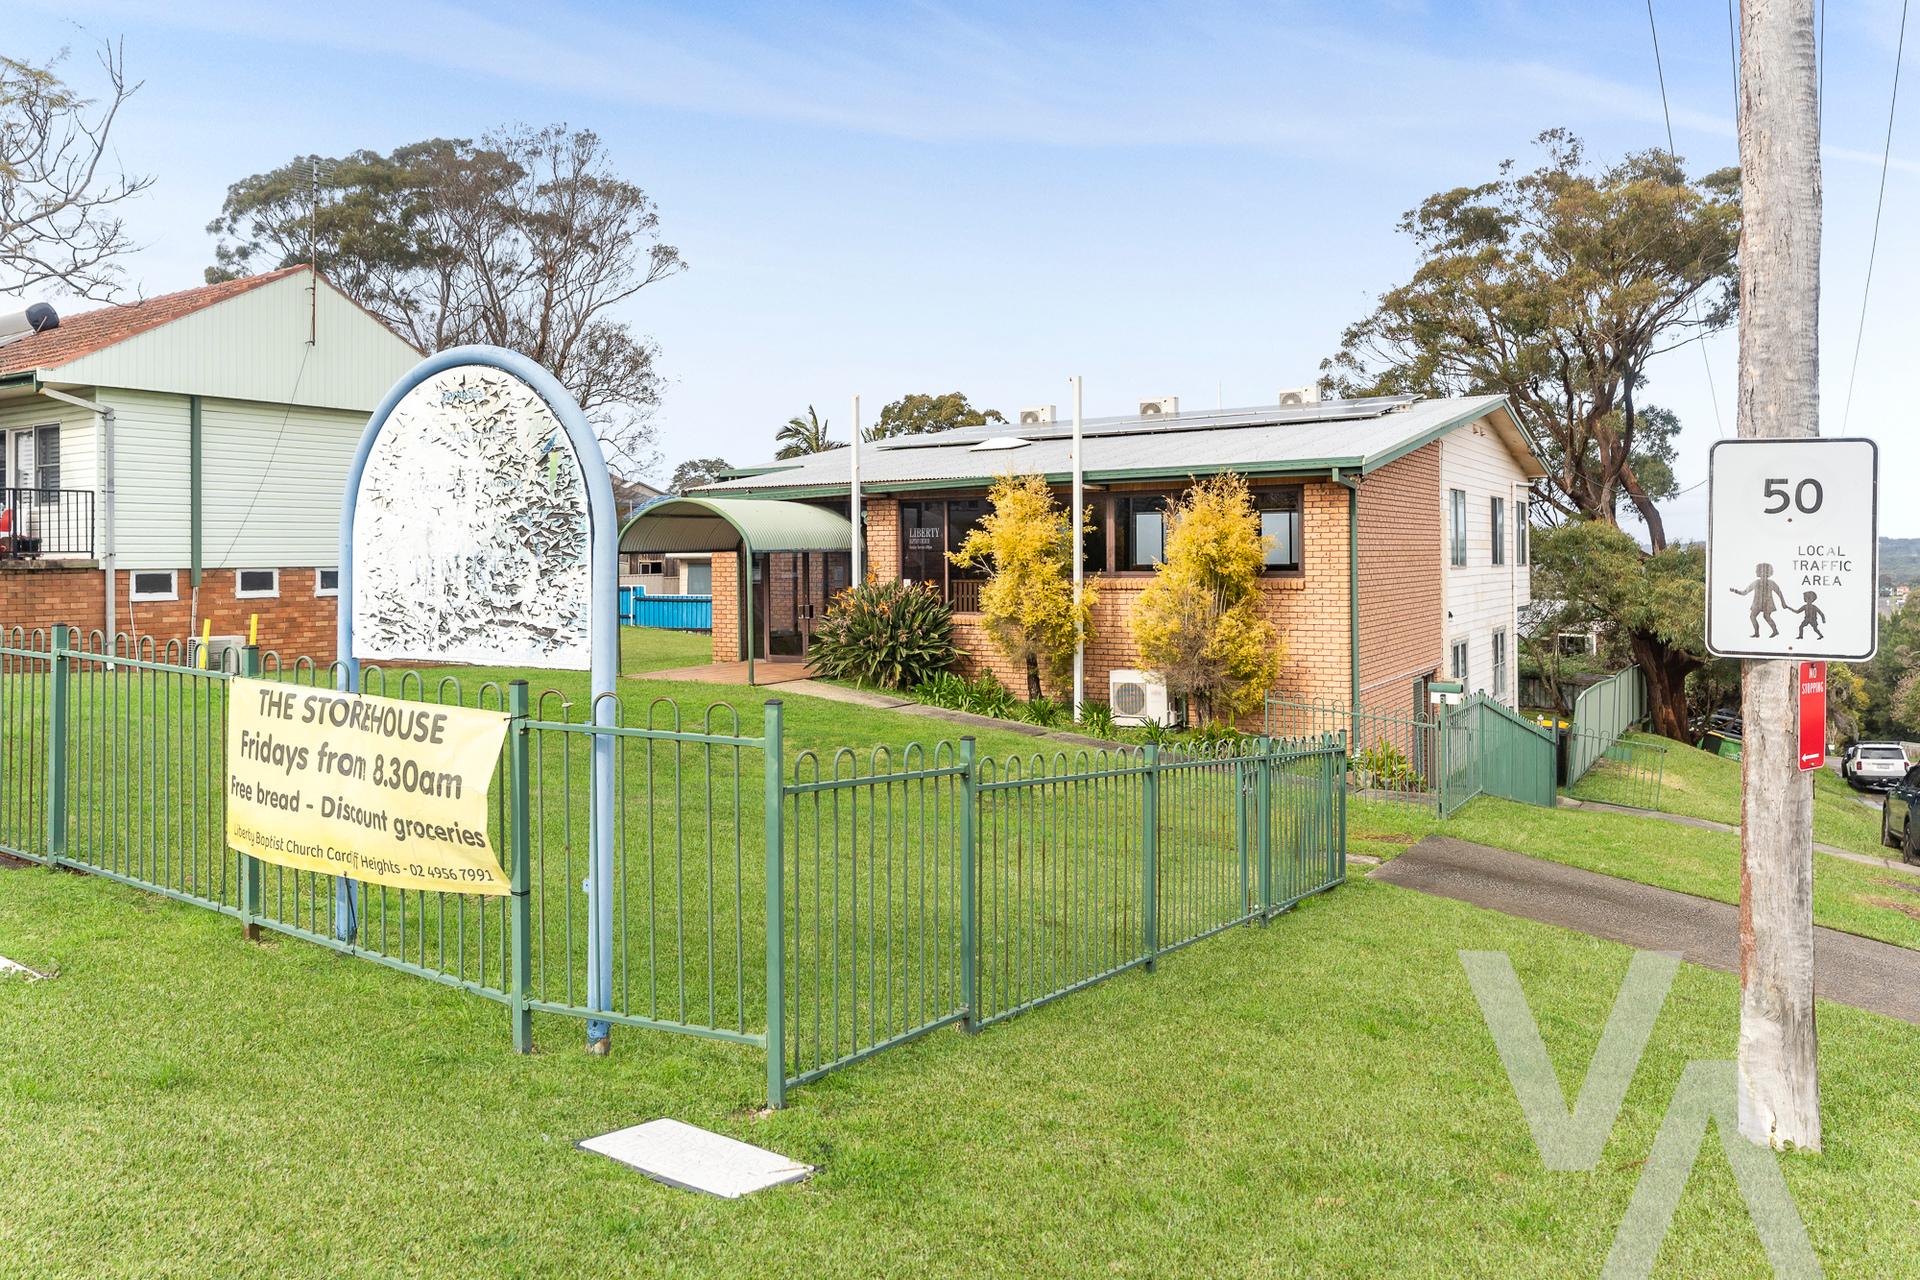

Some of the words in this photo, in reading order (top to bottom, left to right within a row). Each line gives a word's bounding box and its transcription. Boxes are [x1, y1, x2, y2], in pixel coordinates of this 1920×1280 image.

[1763, 478, 1823, 514] 50
[909, 527, 940, 538] LIBERTY
[1798, 544, 1846, 556] LOCAL
[1792, 559, 1852, 571] TRAFFIC
[1801, 575, 1842, 586] AREA
[1808, 667, 1817, 679] NO
[1801, 681, 1824, 695] STOPPING
[259, 689, 297, 720] THE
[302, 695, 448, 744] STOREHOUSE
[241, 730, 309, 776] Fridays
[317, 741, 366, 781] from
[373, 754, 463, 799] 8.30am
[231, 775, 252, 801] Free
[257, 782, 300, 812] bread
[321, 795, 388, 832] Discount
[393, 817, 486, 848] groceries
[234, 823, 255, 846] Liberty
[256, 832, 284, 851] Baptist
[286, 840, 323, 858] Church
[361, 855, 400, 875] Heights
[410, 864, 424, 877] 02
[427, 866, 458, 881] 4956
[459, 868, 494, 882] 7991
